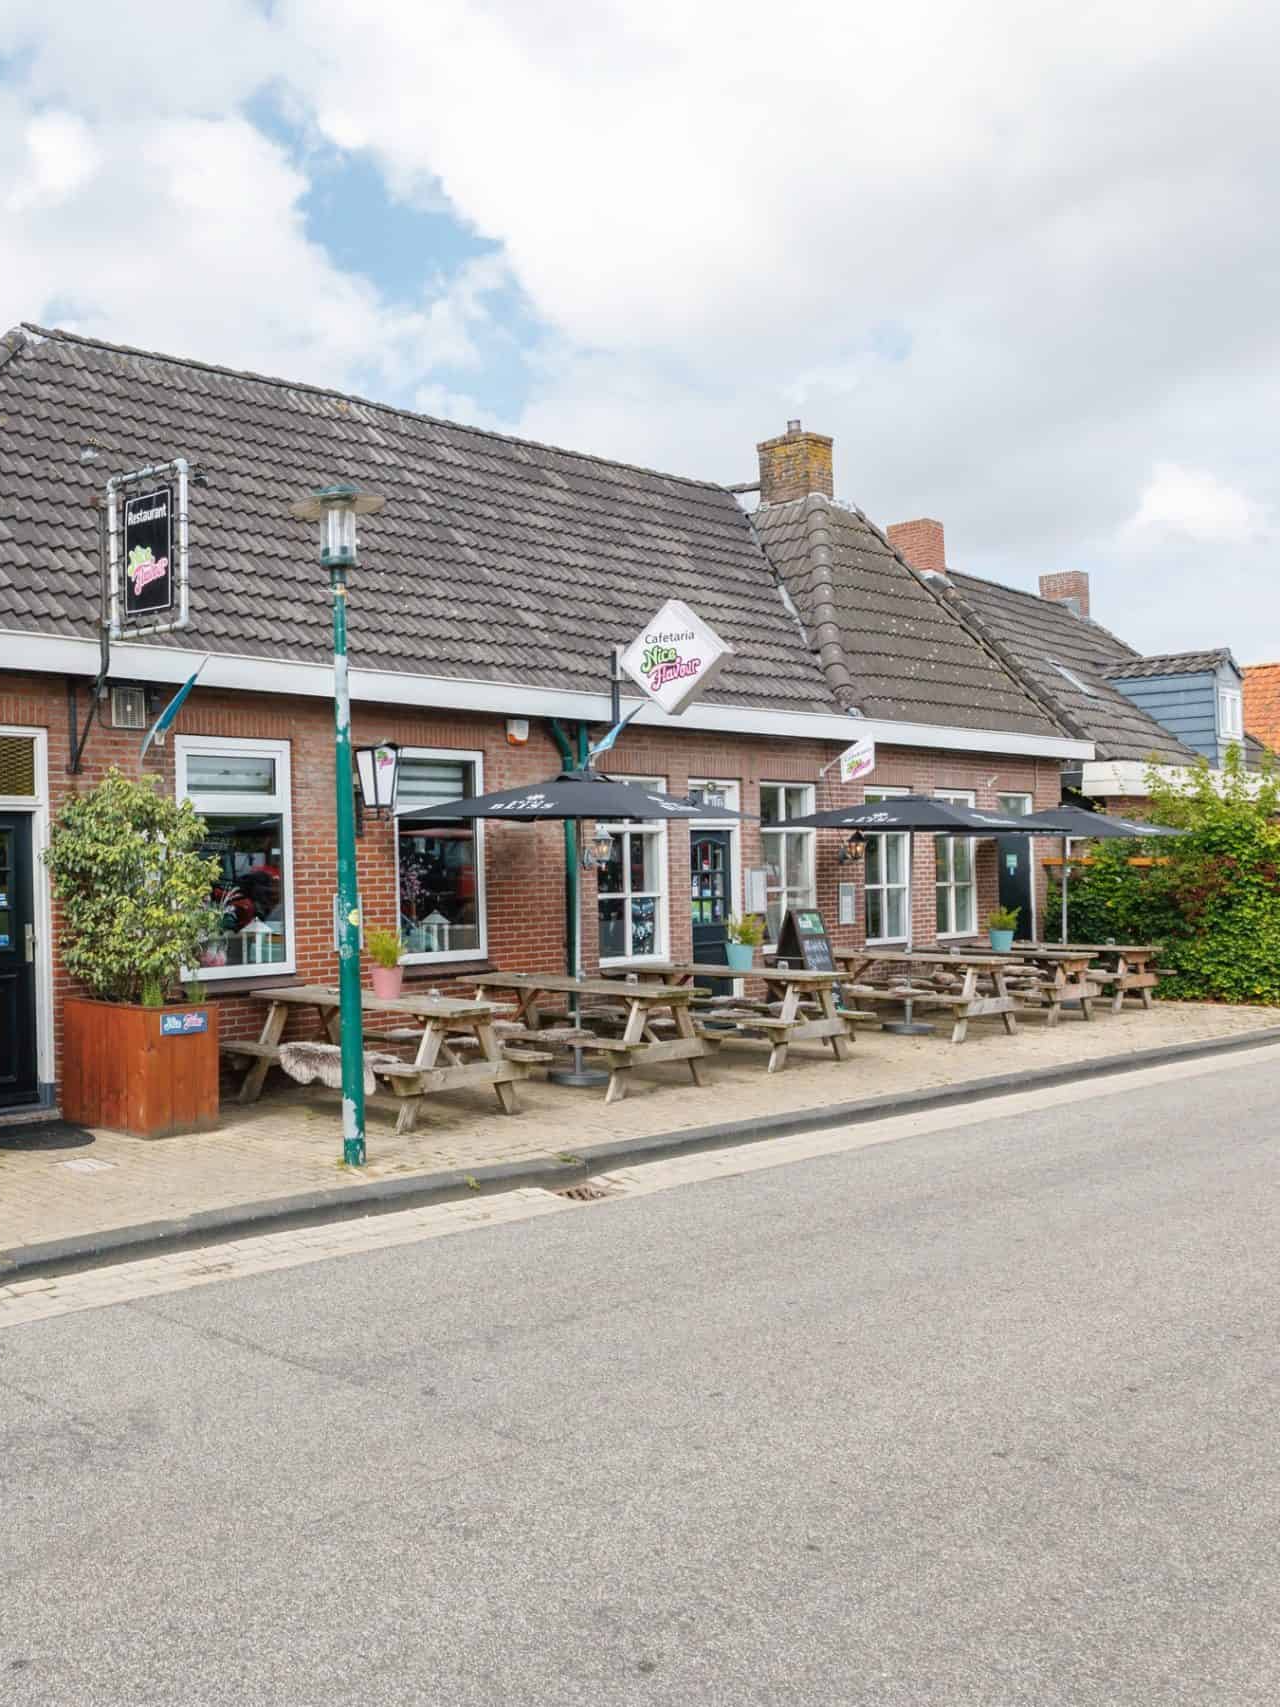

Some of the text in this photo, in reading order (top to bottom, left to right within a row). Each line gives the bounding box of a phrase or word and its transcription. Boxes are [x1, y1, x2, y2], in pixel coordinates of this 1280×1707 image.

[127, 503, 167, 526] Restaurant
[644, 630, 695, 645] Cafetaria
[640, 645, 677, 674] Nice
[647, 655, 702, 692] Flavour
